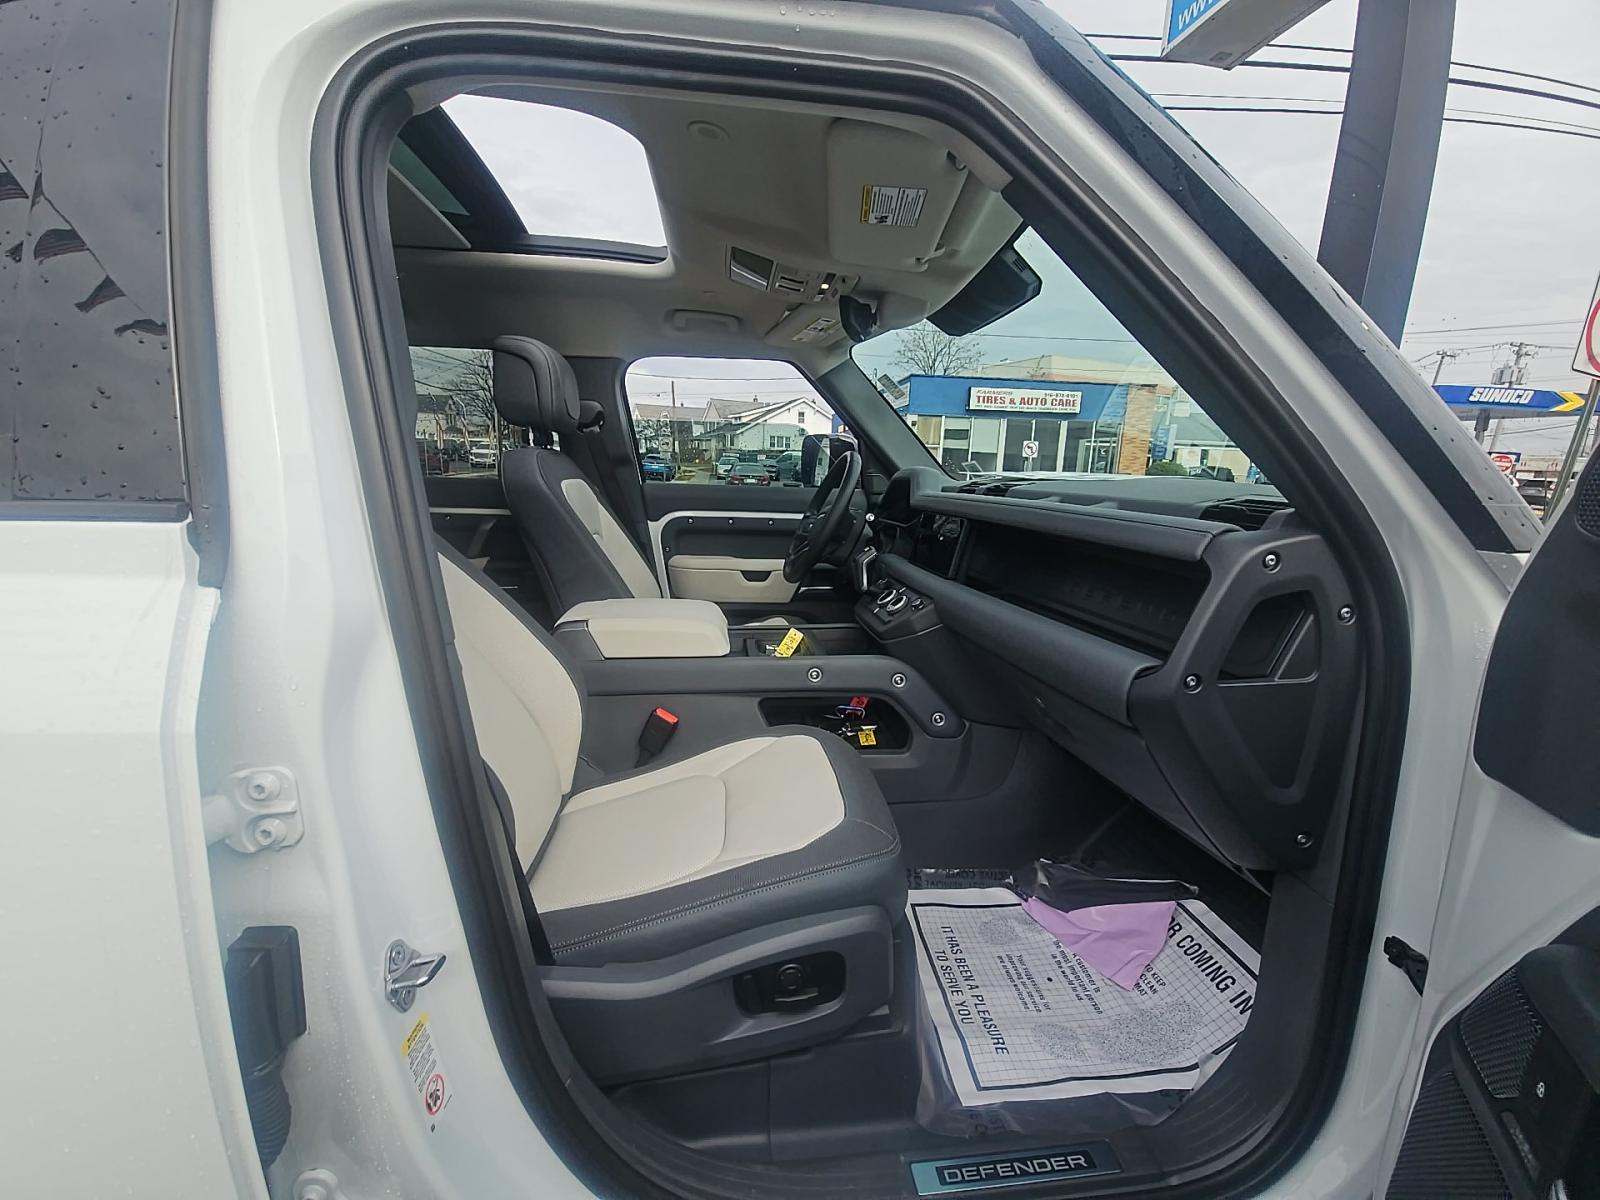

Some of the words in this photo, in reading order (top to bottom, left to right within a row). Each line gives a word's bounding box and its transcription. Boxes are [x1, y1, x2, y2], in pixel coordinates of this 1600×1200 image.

[976, 395, 1006, 405] TIRES
[1009, 397, 1016, 406] &
[1019, 397, 1047, 406] AUTO
[1050, 398, 1078, 408] CARE
[1469, 387, 1535, 404] SUNOCO
[941, 925, 954, 937] IT
[935, 949, 948, 962] TO
[945, 935, 963, 955] HAS
[955, 957, 976, 982] BEEN
[1176, 935, 1236, 993] COMING
[940, 965, 964, 997] SERVE
[1140, 973, 1158, 995] CLEAN
[1151, 971, 1166, 988] KEEP
[955, 1000, 975, 1025] YOU
[1084, 992, 1103, 1015] person
[971, 994, 1010, 1055] PLEASURE
[943, 1155, 1088, 1184] DEFENDER
